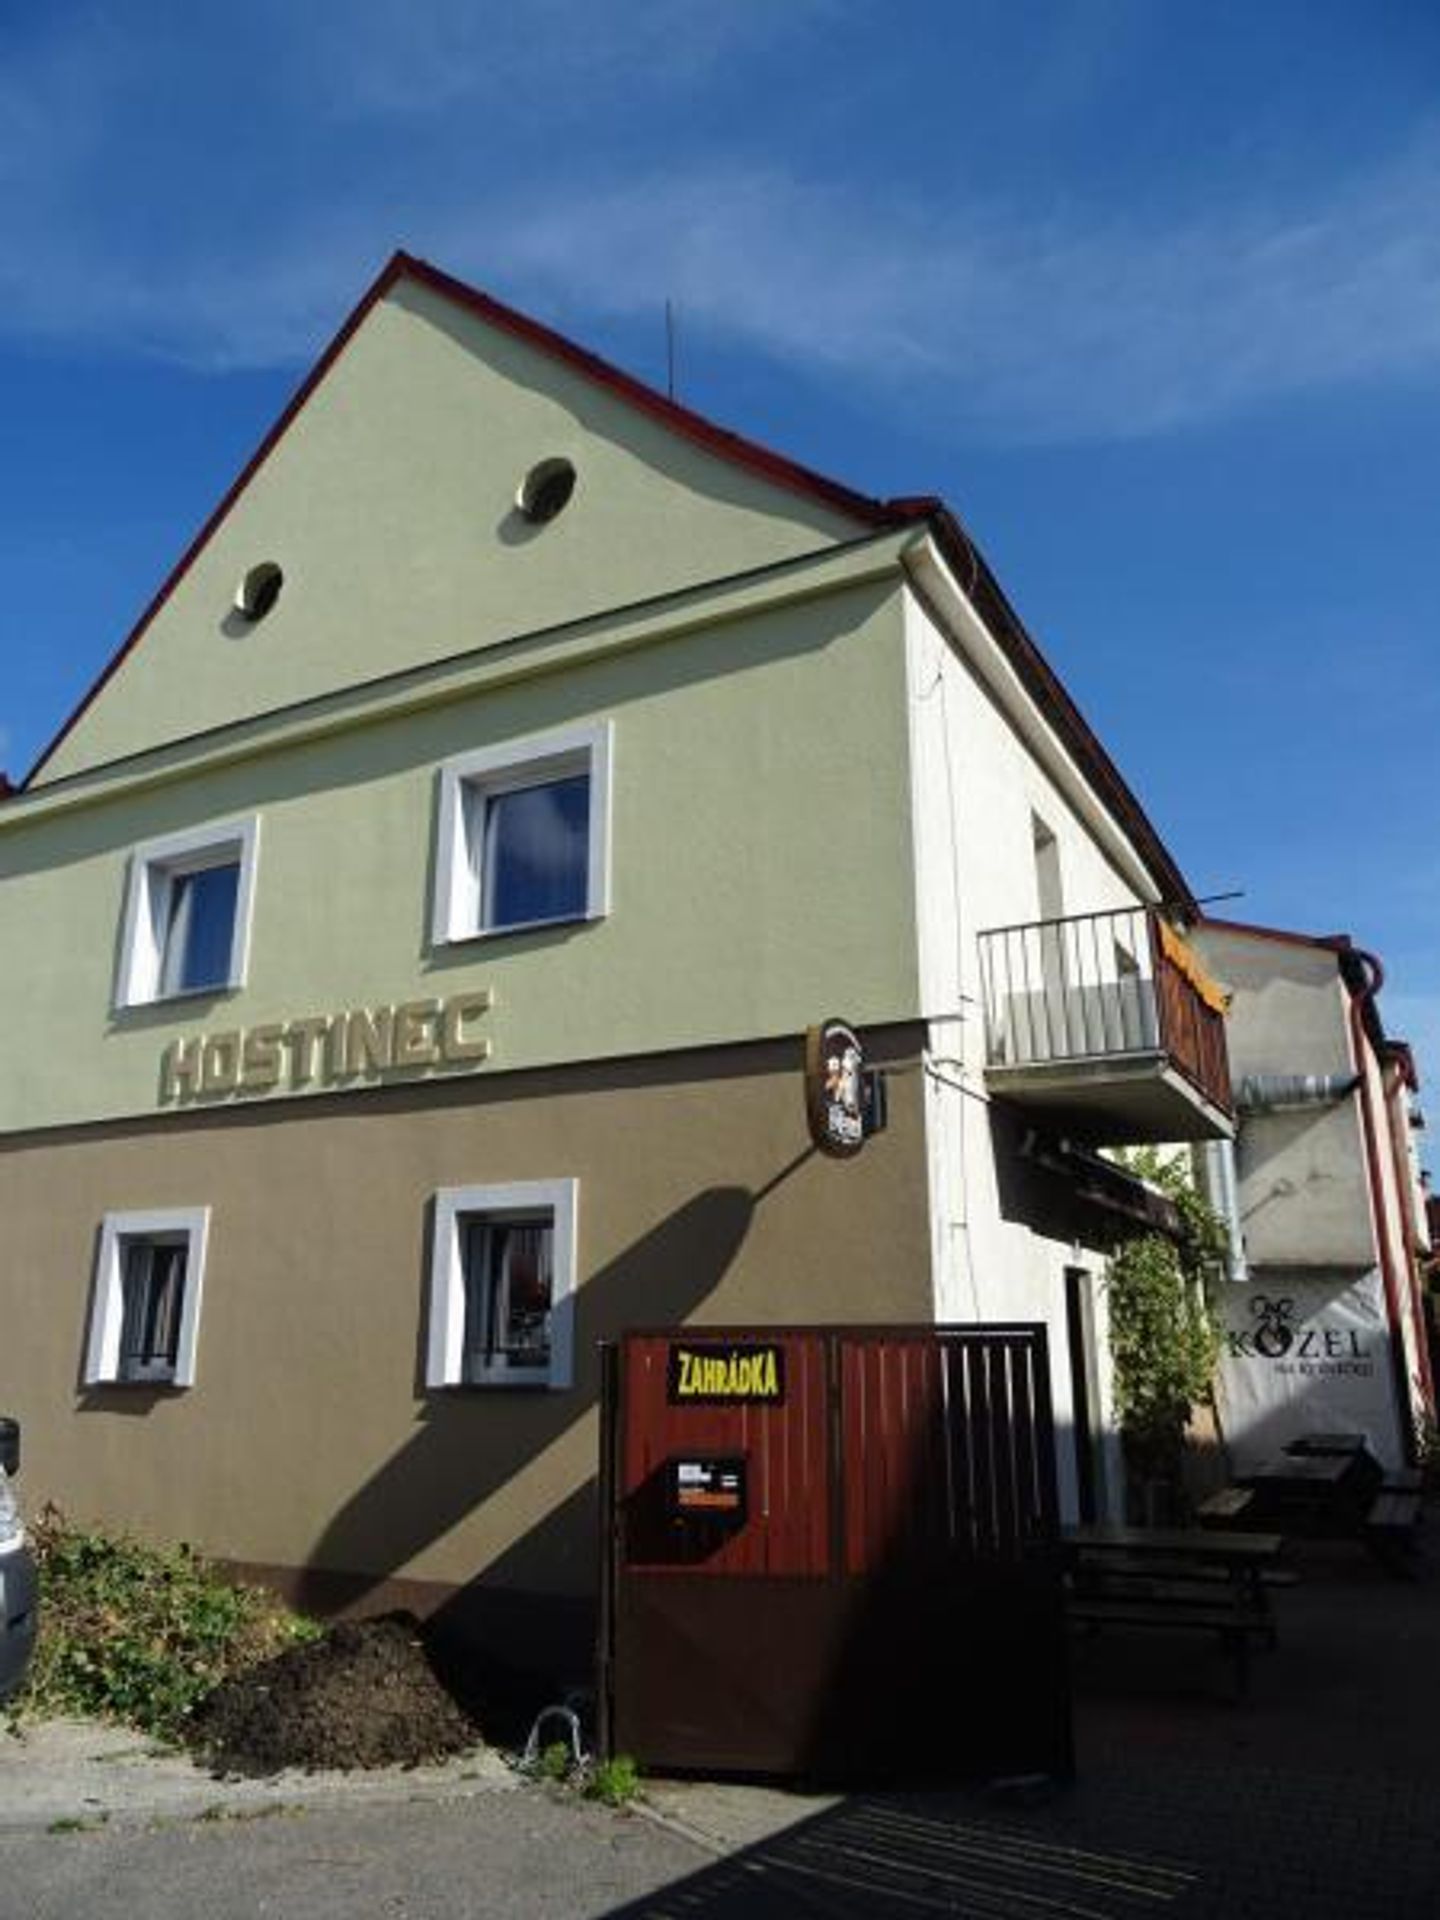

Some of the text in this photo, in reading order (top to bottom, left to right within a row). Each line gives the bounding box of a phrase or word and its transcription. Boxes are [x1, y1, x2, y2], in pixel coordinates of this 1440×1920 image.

[162, 988, 494, 1104] HOSTINEC
[1229, 1322, 1372, 1358] KOZEL
[678, 1350, 779, 1395] ZAHRÁDKA
